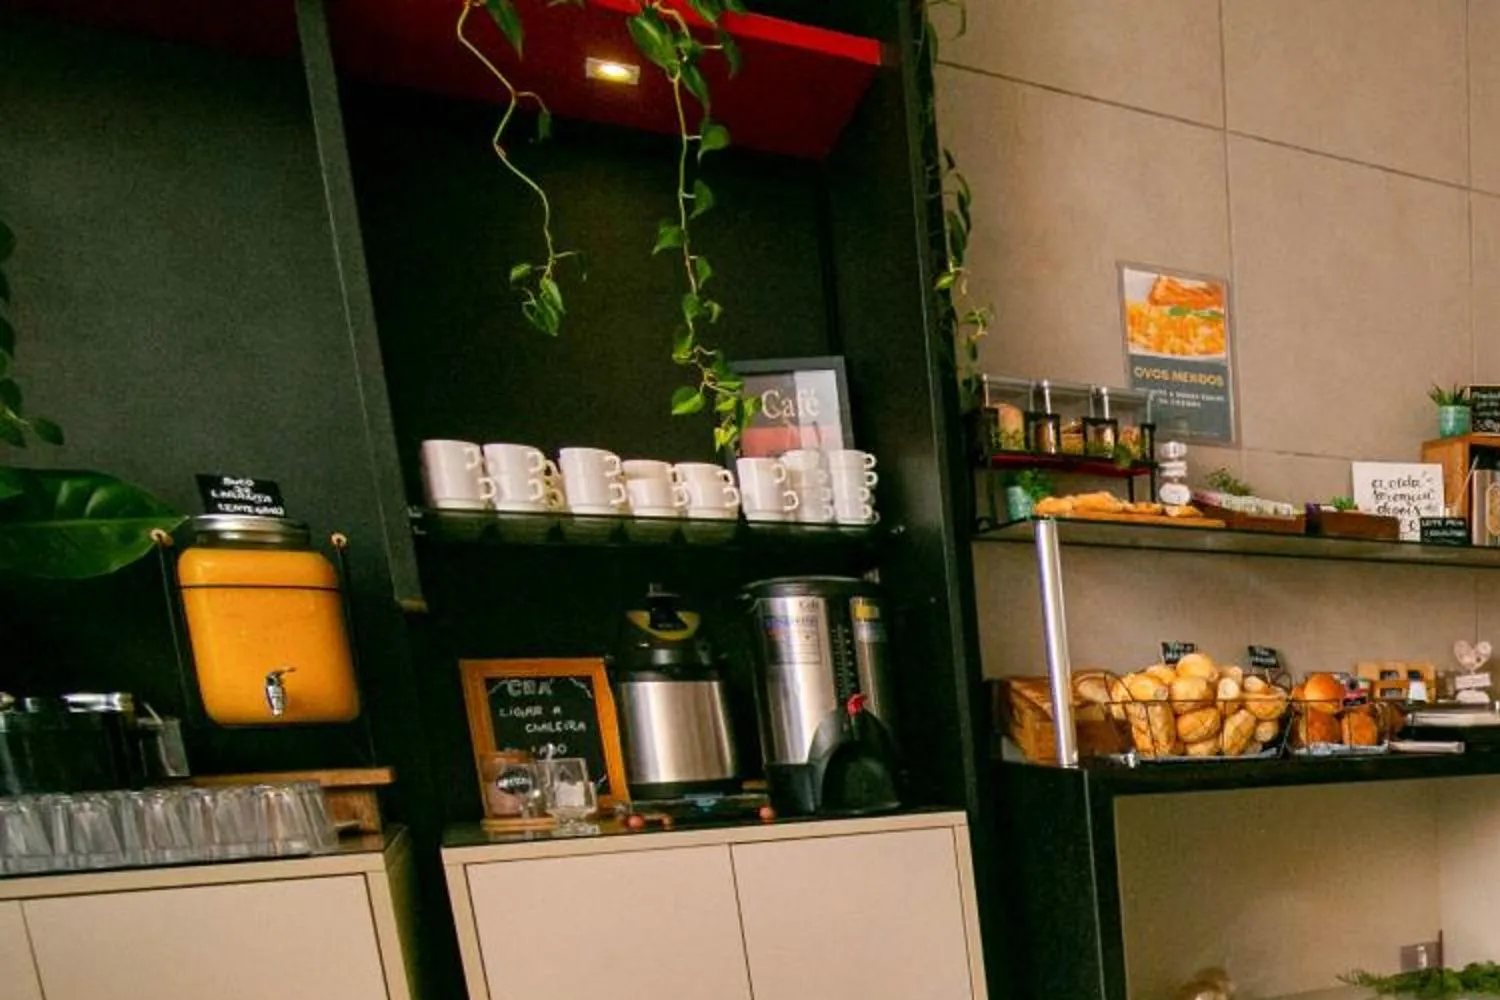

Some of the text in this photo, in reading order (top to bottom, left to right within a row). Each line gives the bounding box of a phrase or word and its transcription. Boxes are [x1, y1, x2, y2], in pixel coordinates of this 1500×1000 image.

[1133, 366, 1225, 387] OVOS MEXIDOS
[761, 387, 821, 420] Café
